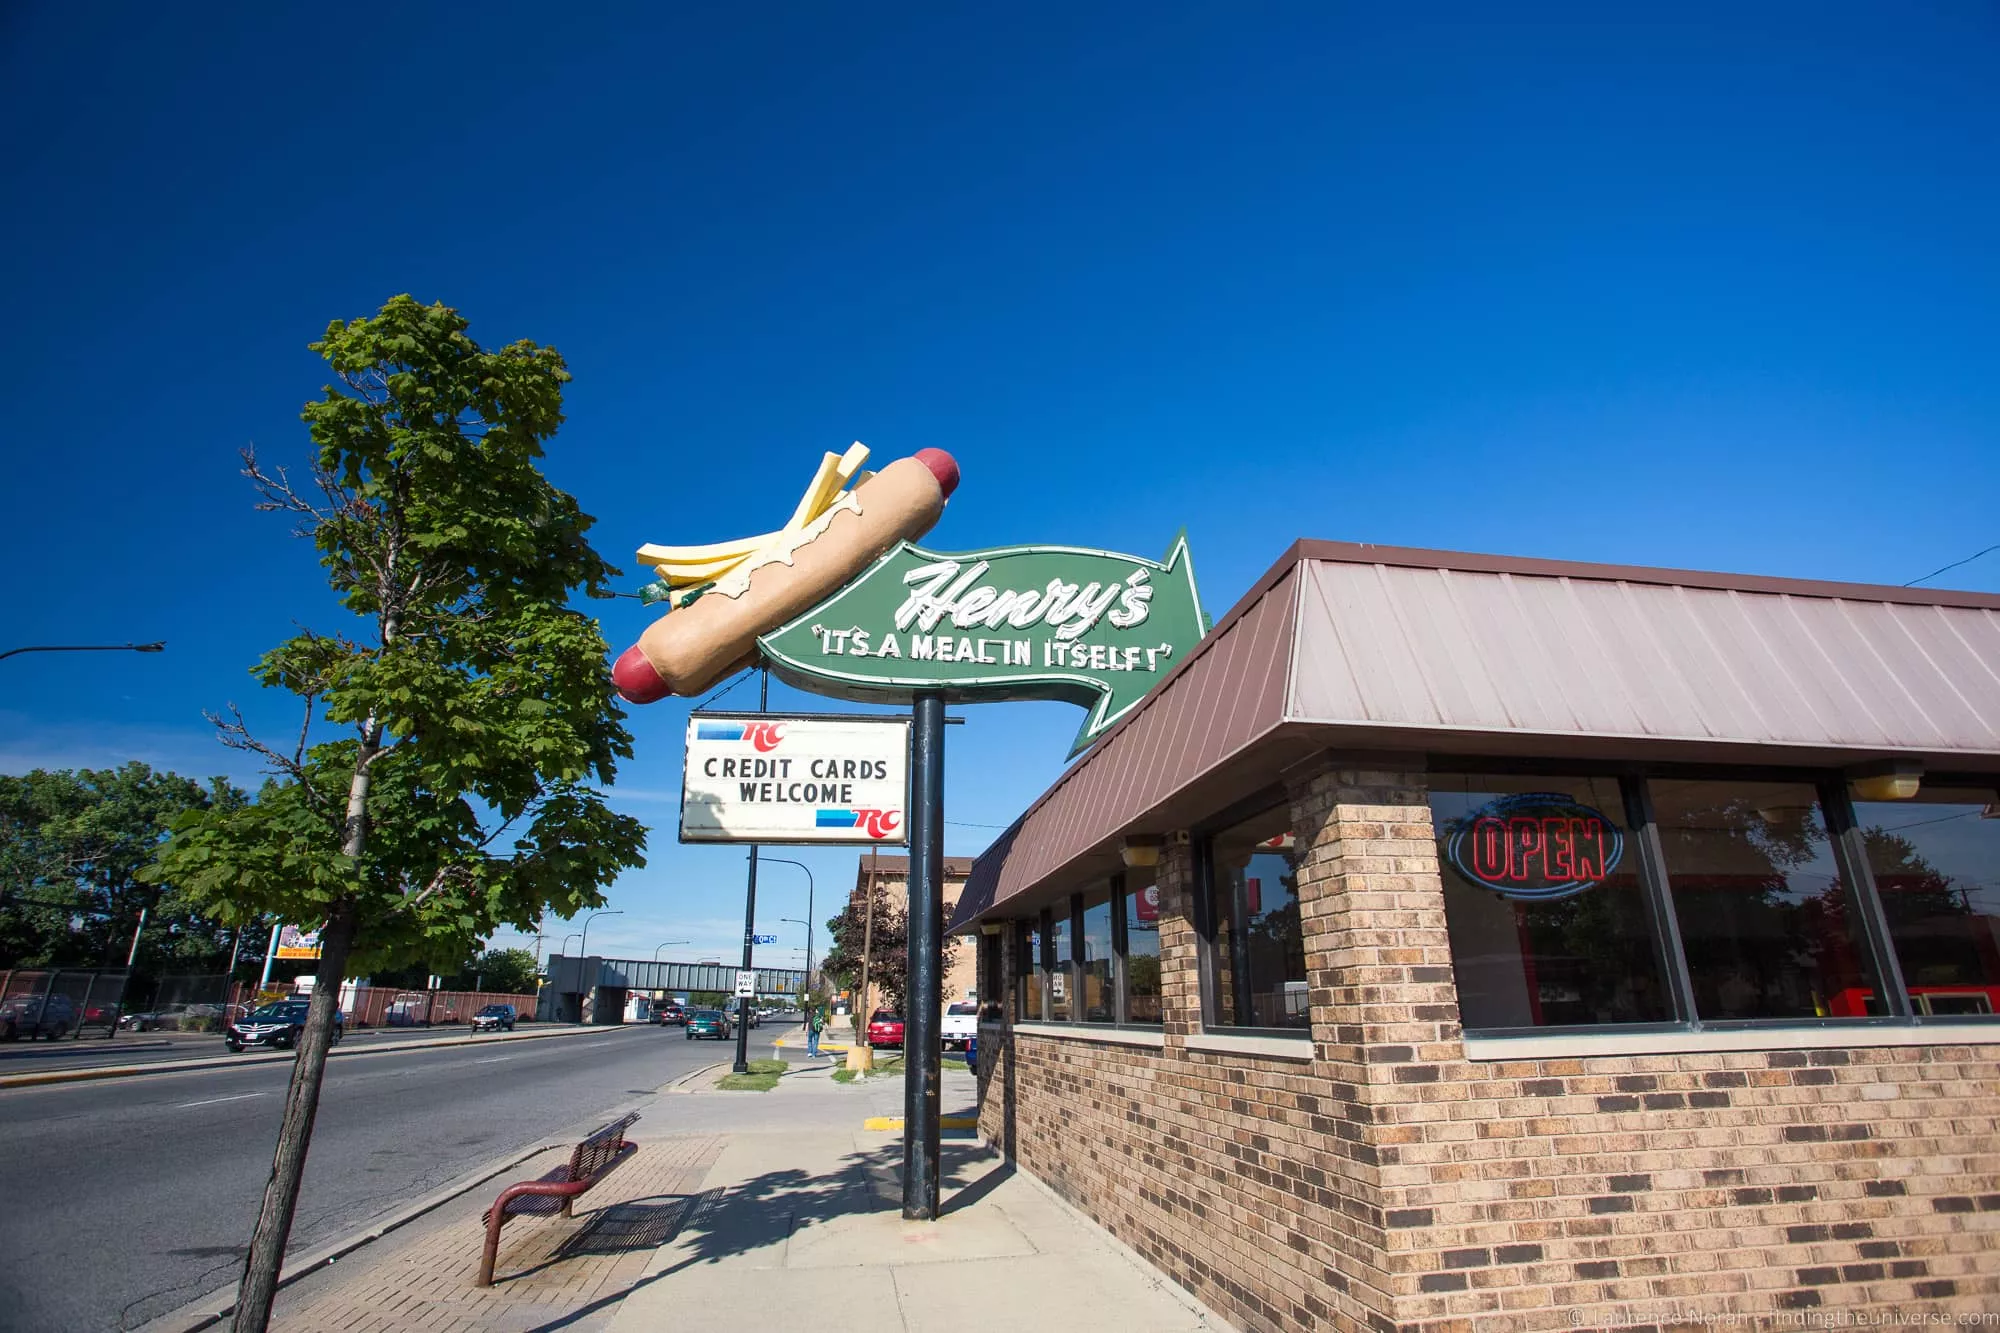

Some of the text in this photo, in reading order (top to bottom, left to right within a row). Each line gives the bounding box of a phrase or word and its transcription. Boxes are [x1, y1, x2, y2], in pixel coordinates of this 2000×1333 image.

[894, 560, 1153, 640] Henry's
[878, 633, 902, 659] A
[911, 634, 997, 665] MEAL
[1003, 637, 1032, 667] IN
[737, 722, 788, 752] RC
[704, 757, 887, 780] CREDIT CARDS
[740, 782, 852, 803] WELCOME
[852, 809, 901, 839] RC
[1473, 816, 1606, 881] OPEN
